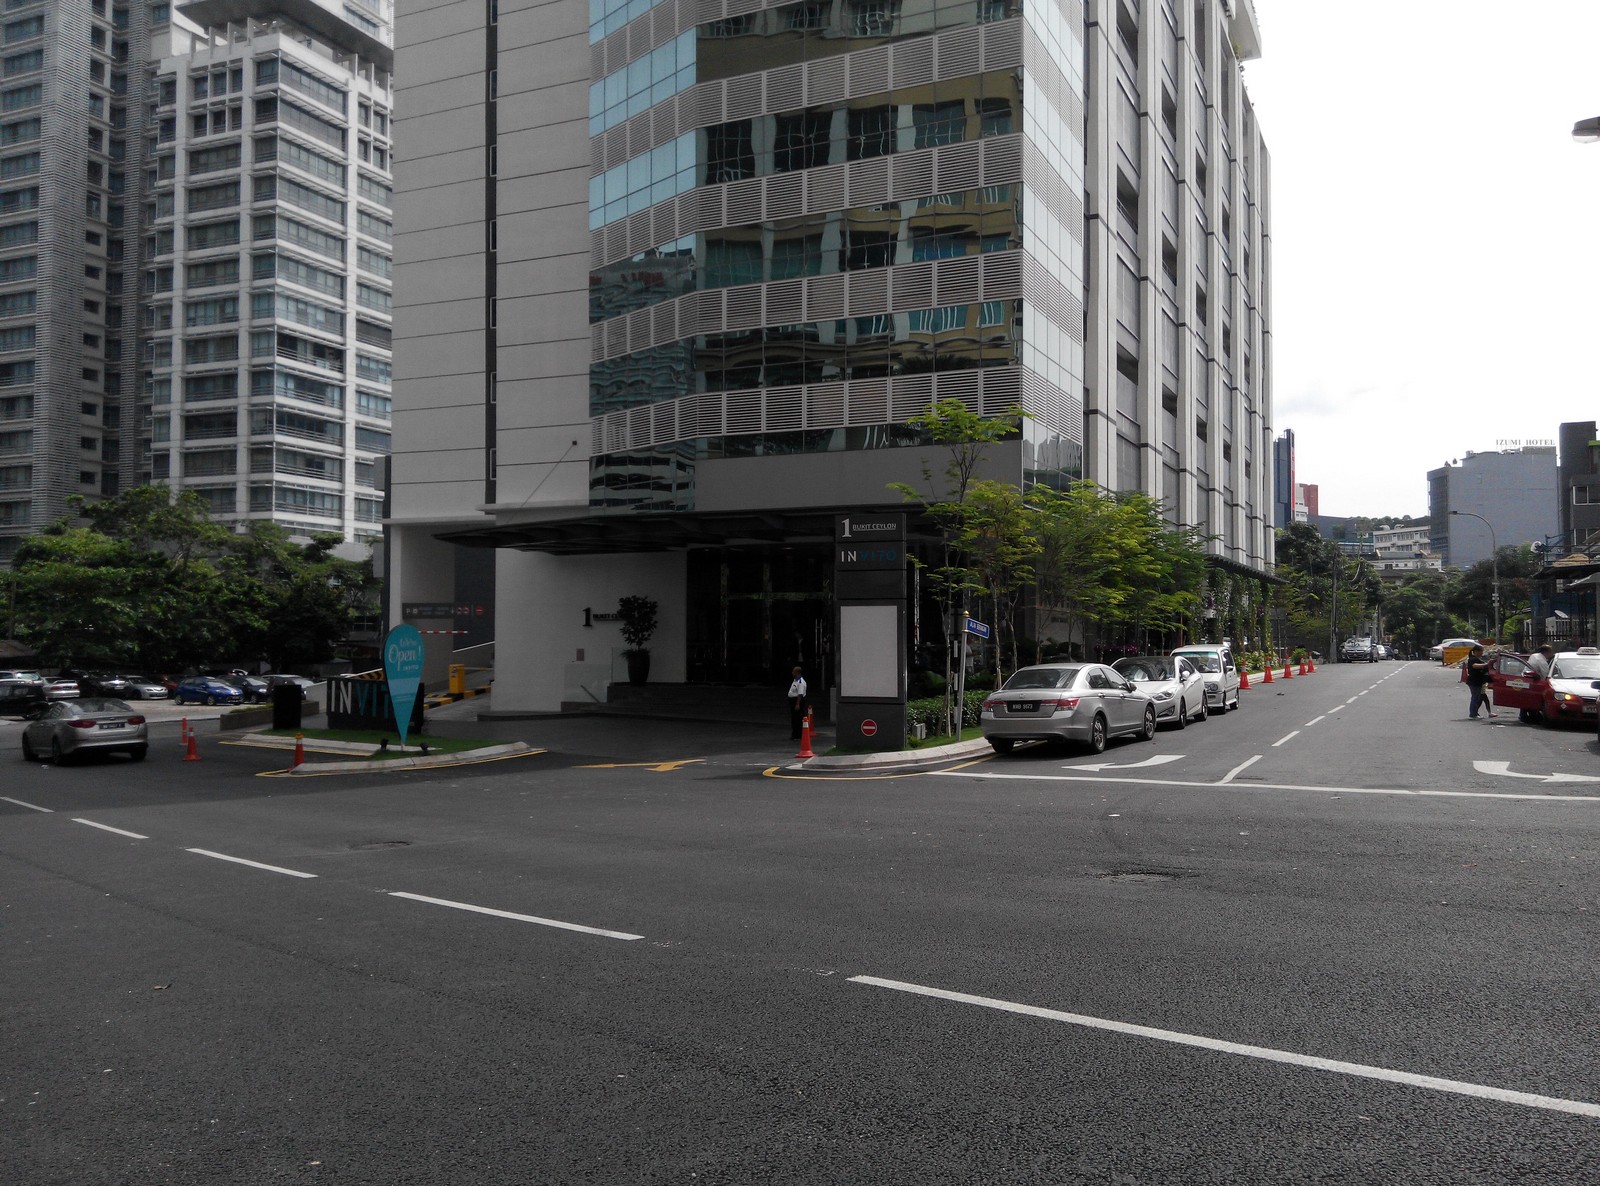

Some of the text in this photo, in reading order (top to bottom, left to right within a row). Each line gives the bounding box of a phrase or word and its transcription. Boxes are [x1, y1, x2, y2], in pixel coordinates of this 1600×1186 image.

[841, 517, 852, 538] 1
[841, 548, 897, 563] INVITO
[582, 606, 593, 627] 1
[330, 679, 389, 719] INVIT
